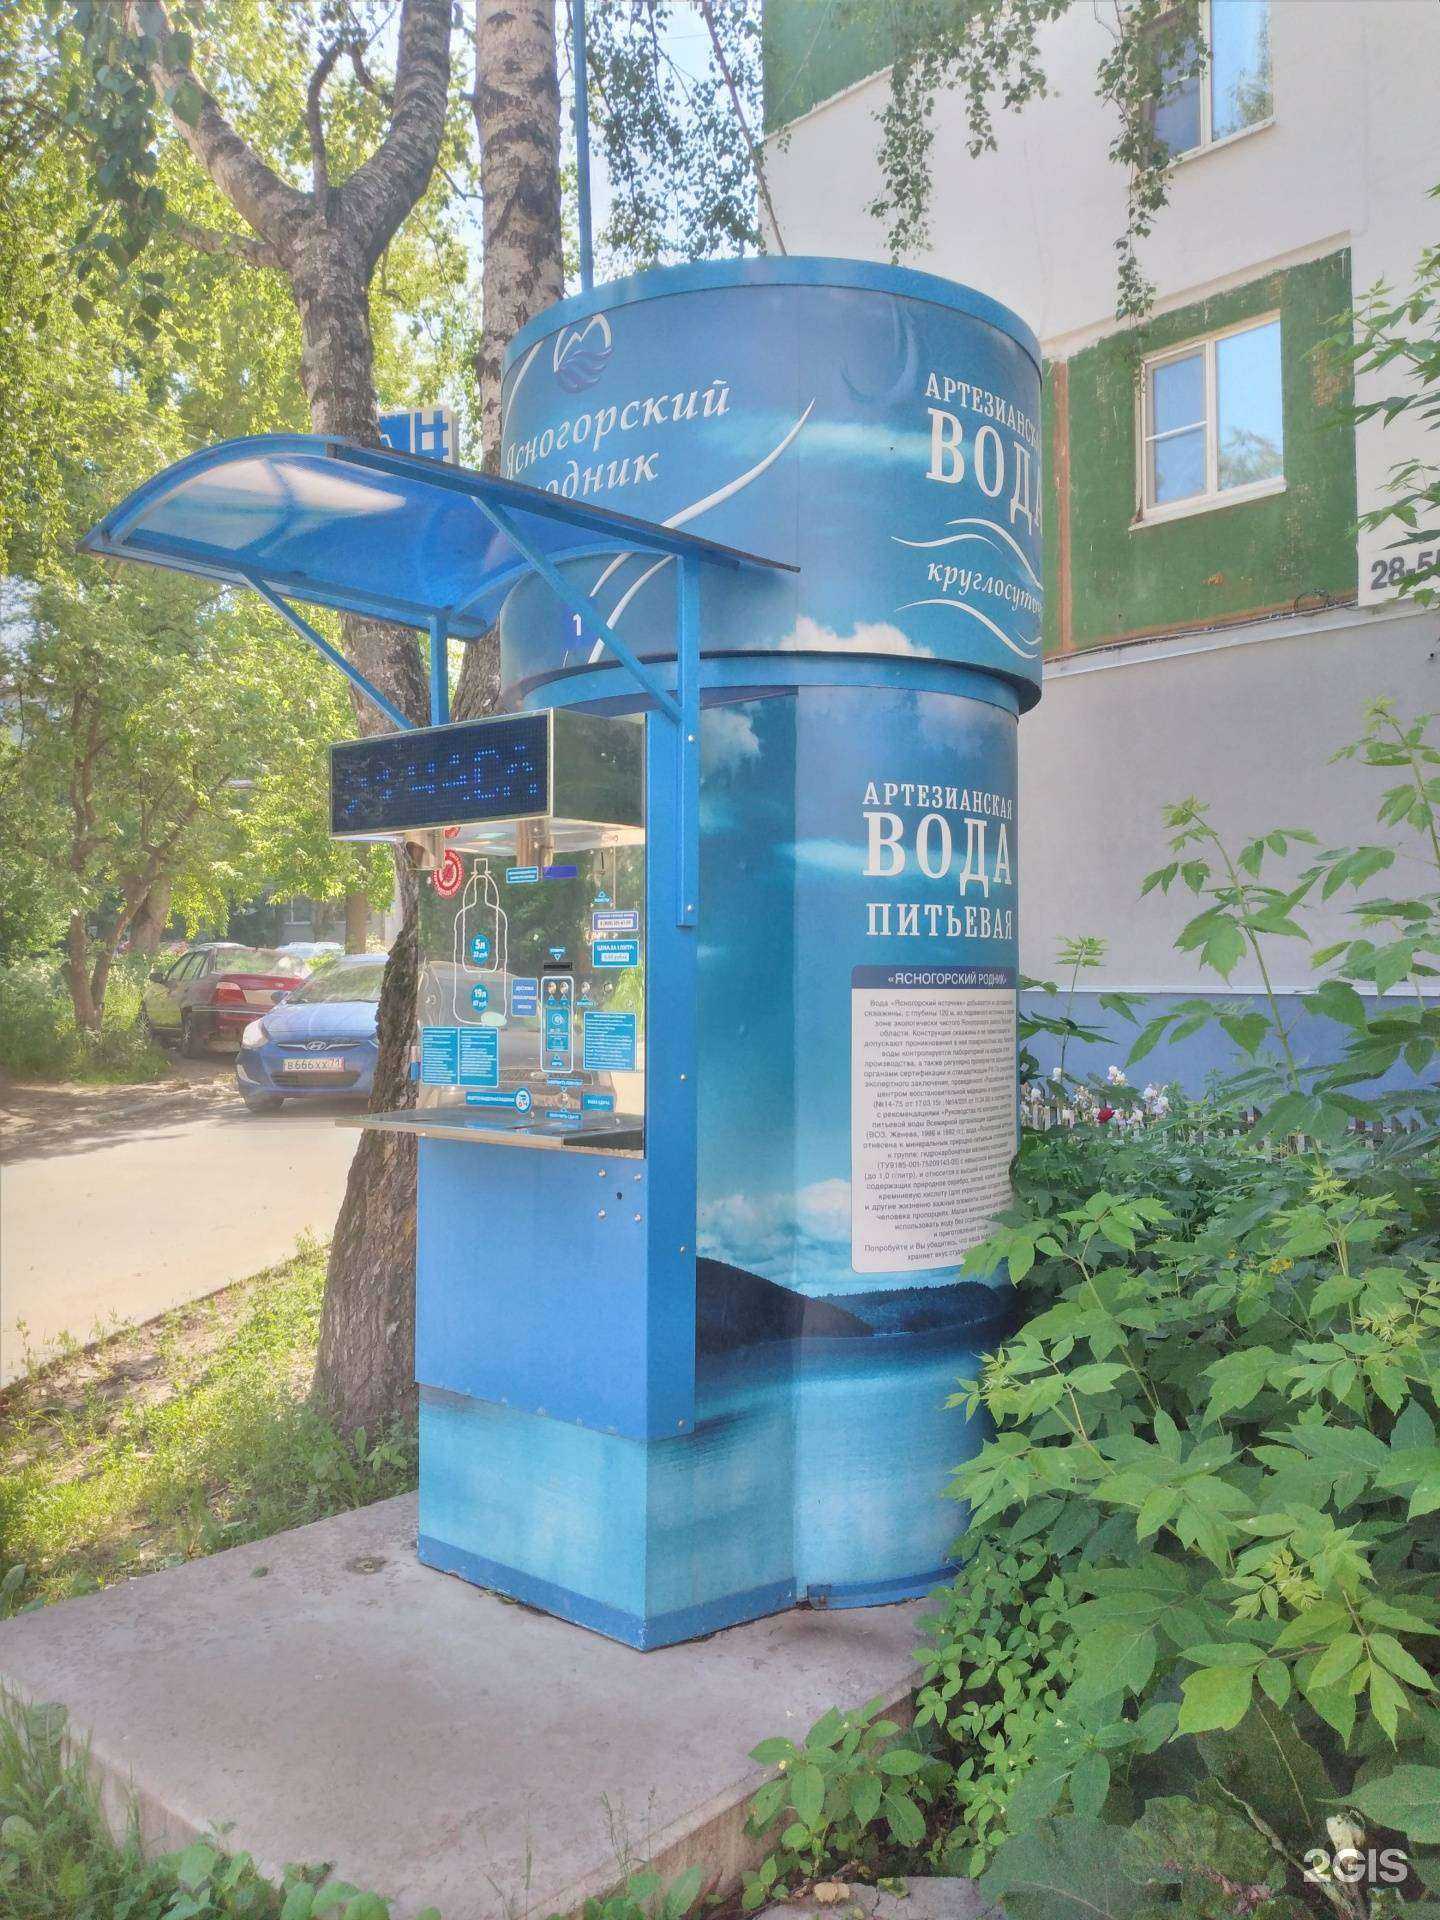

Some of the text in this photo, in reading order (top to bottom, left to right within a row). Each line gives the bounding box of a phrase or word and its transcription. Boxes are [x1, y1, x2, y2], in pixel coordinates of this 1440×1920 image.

[506, 379, 731, 480] Ясногорский
[537, 451, 660, 499] одник
[862, 782, 1012, 820] АРТЕЗИАНСКАЯ
[862, 811, 1012, 898] ВОДА
[866, 903, 1012, 940] ПИТЬЕВАЯ
[888, 971, 977, 985] «ЯСНОГОРСКИЙ
